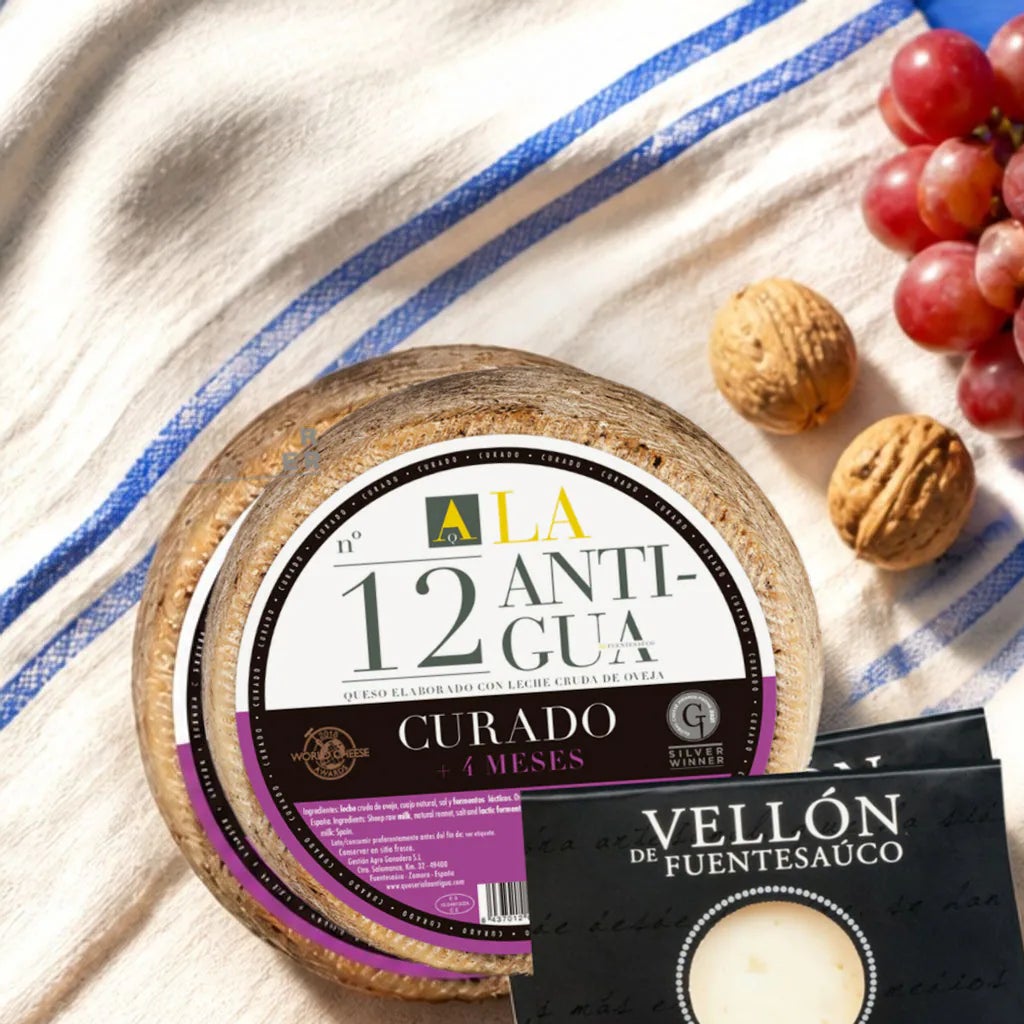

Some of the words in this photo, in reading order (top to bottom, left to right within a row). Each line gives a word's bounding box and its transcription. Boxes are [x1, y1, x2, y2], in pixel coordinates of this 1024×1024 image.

[490, 485, 592, 545] LA
[498, 544, 698, 609] ANTI-
[342, 566, 483, 673] 12
[502, 609, 659, 672] GUA
[343, 688, 387, 703] QUESO
[391, 684, 473, 698] ELABORADO
[477, 680, 503, 692] CON
[507, 677, 551, 690] LECHE
[554, 674, 598, 687] CRUDA
[603, 672, 620, 683] DE
[624, 670, 665, 682] OVEJA
[398, 702, 617, 751] CURADO
[462, 755, 473, 777] 4
[486, 748, 585, 776] MESES
[668, 746, 724, 759] SILVER
[669, 756, 724, 768] WINNER
[340, 804, 356, 813] leche
[374, 802, 382, 811] de
[641, 786, 901, 850] VELLÓN
[630, 847, 658, 863] DE
[664, 838, 904, 877] FUENTESAÚCO
